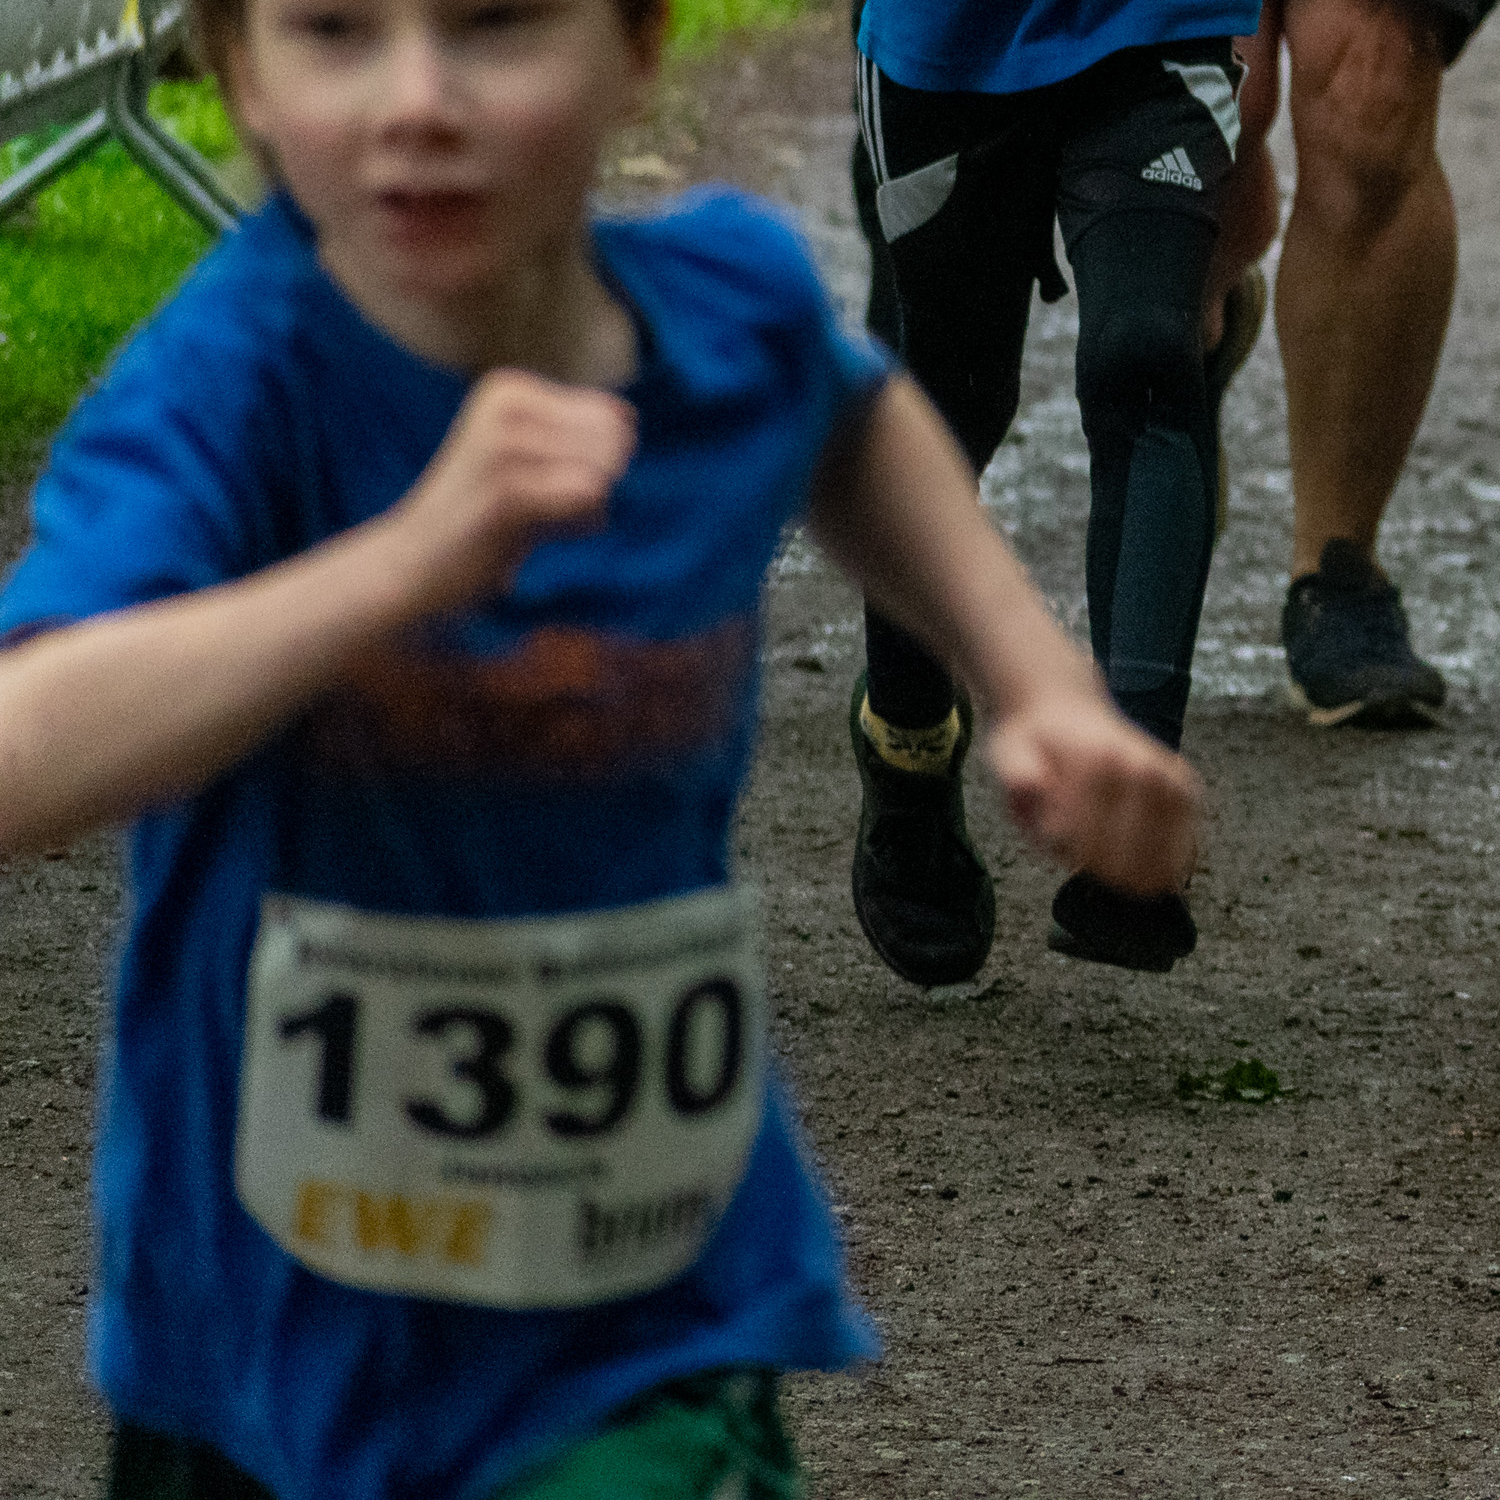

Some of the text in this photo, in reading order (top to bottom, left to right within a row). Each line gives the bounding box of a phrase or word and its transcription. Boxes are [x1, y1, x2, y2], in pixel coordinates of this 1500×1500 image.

[1142, 167, 1203, 191] adidas
[277, 974, 743, 1143] 1390
[296, 1181, 490, 1265] EWE
